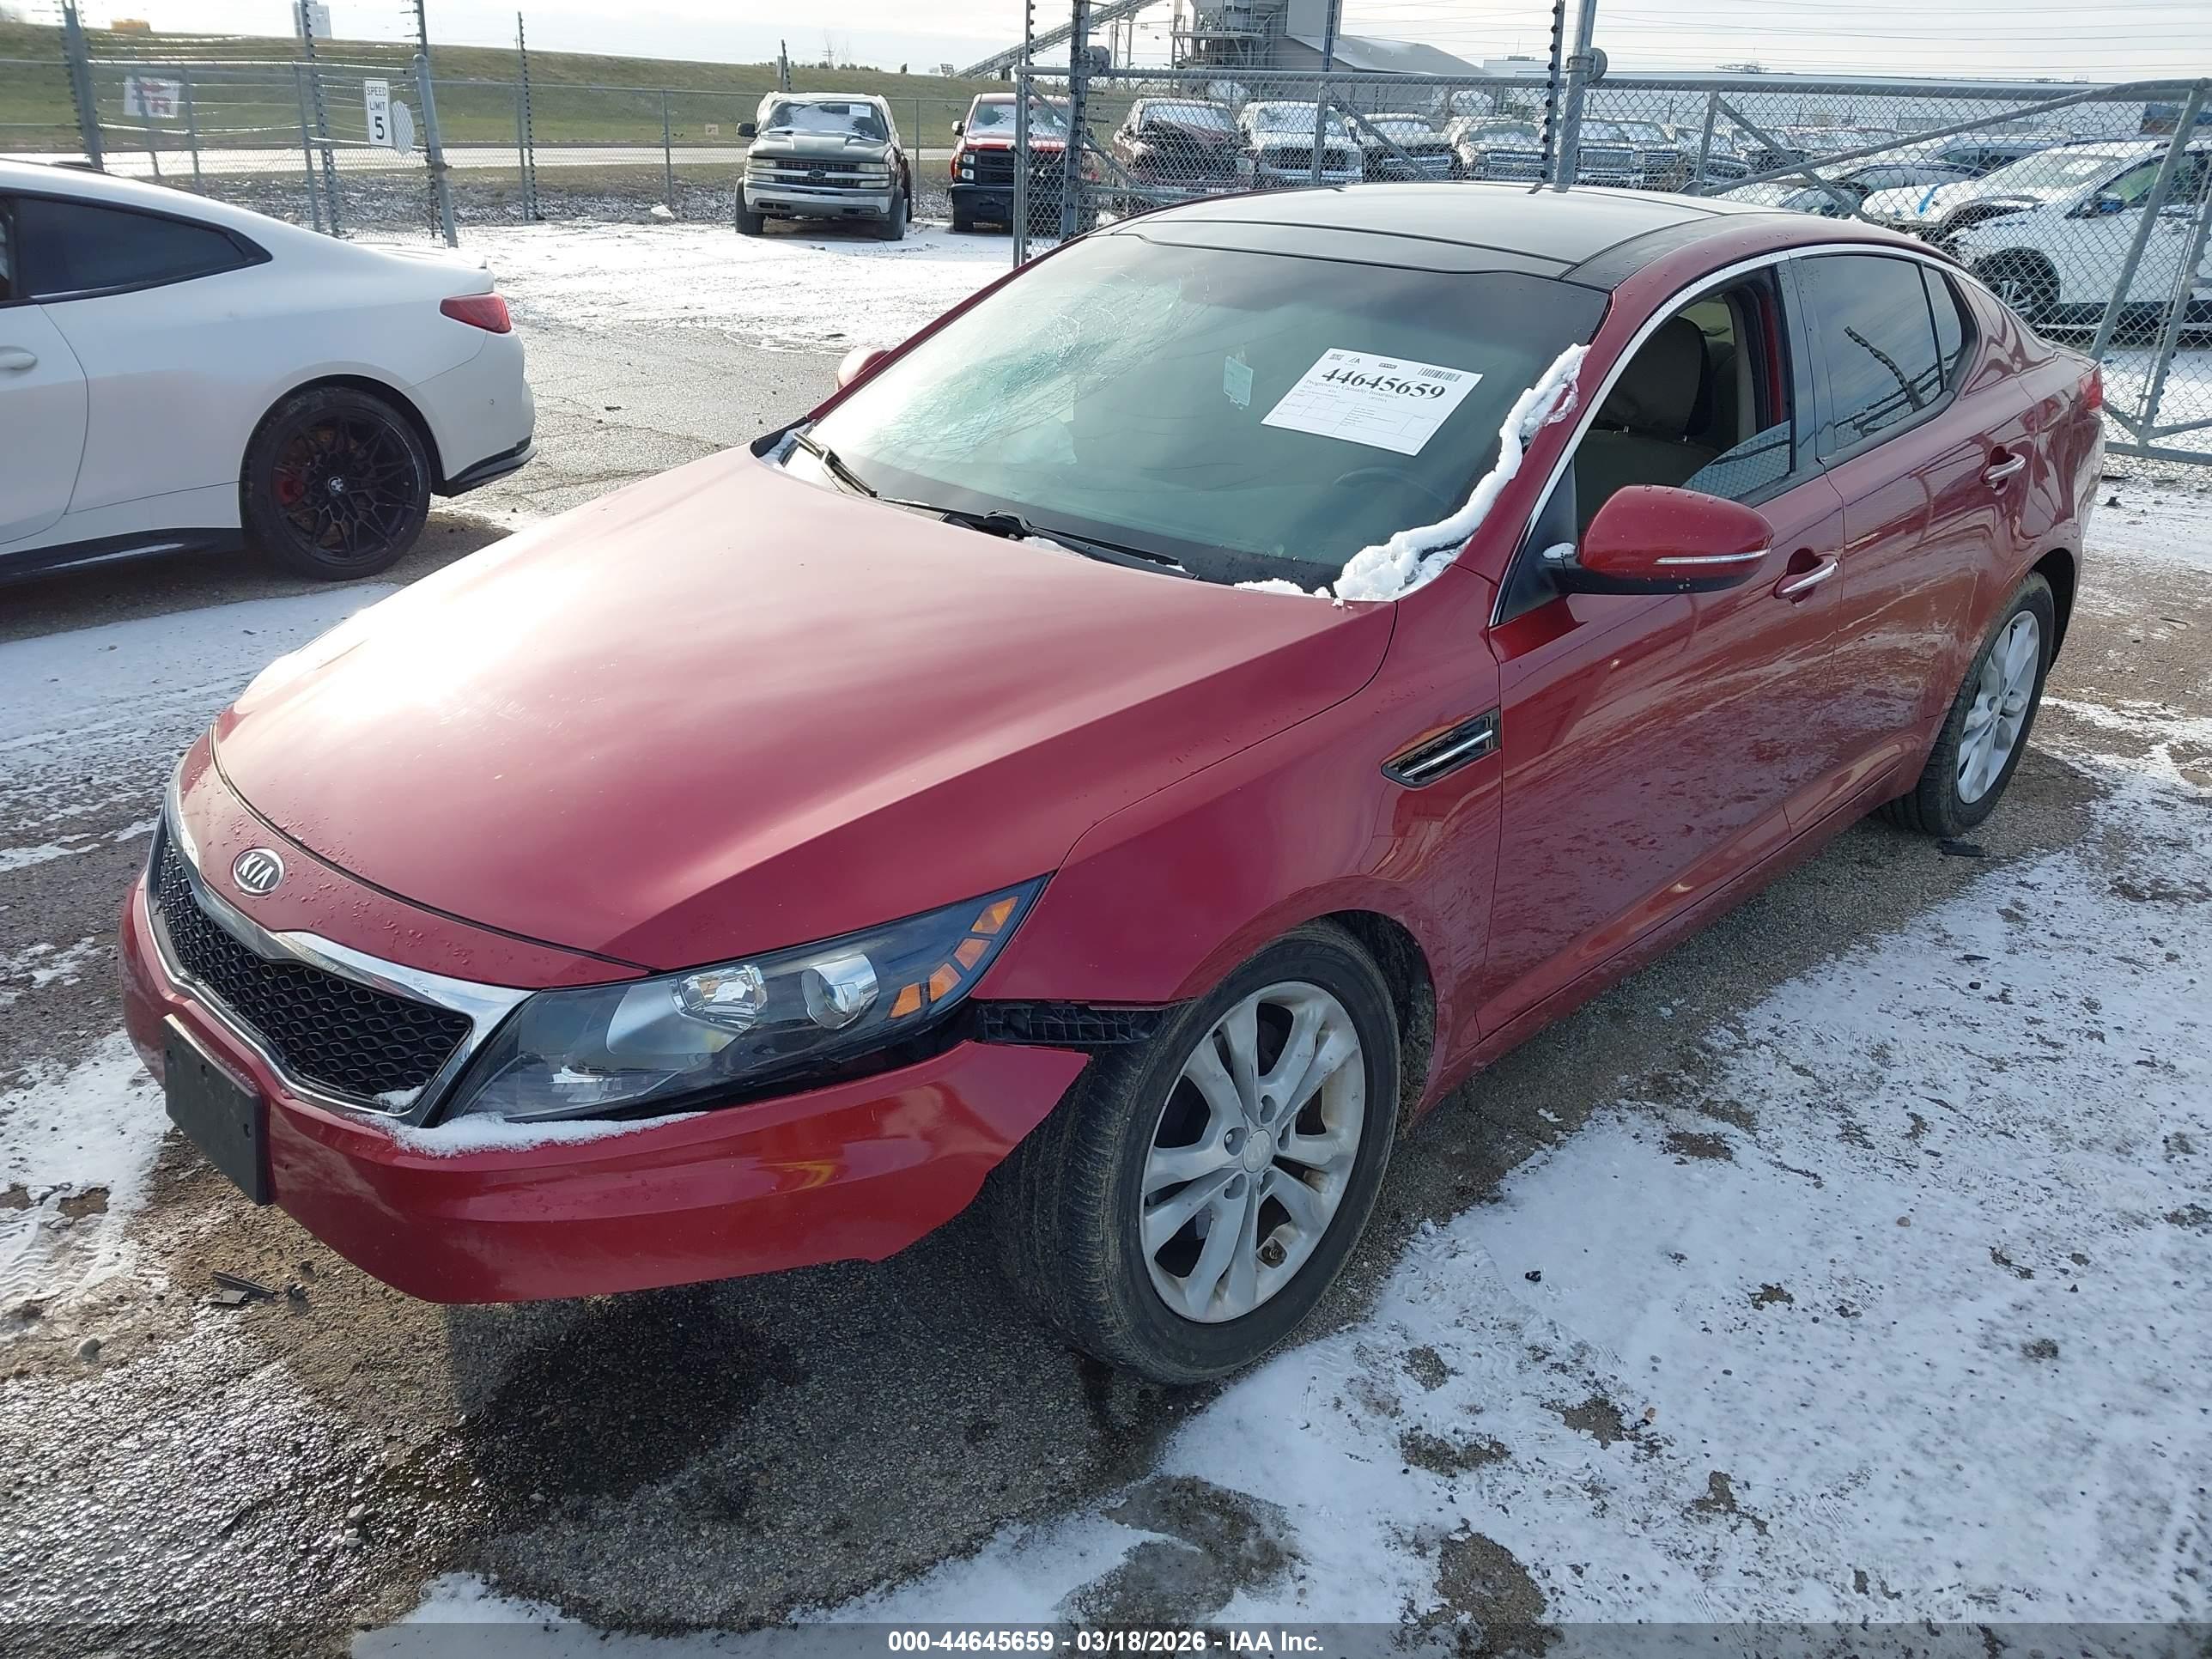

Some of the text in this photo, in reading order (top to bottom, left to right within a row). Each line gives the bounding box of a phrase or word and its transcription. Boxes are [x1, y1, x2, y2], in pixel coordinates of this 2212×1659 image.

[366, 86, 386, 96] SPEED
[369, 100, 385, 111] LIMIT
[374, 116, 385, 140] 5
[1322, 368, 1446, 400] 44645659
[237, 853, 275, 890] KIA
